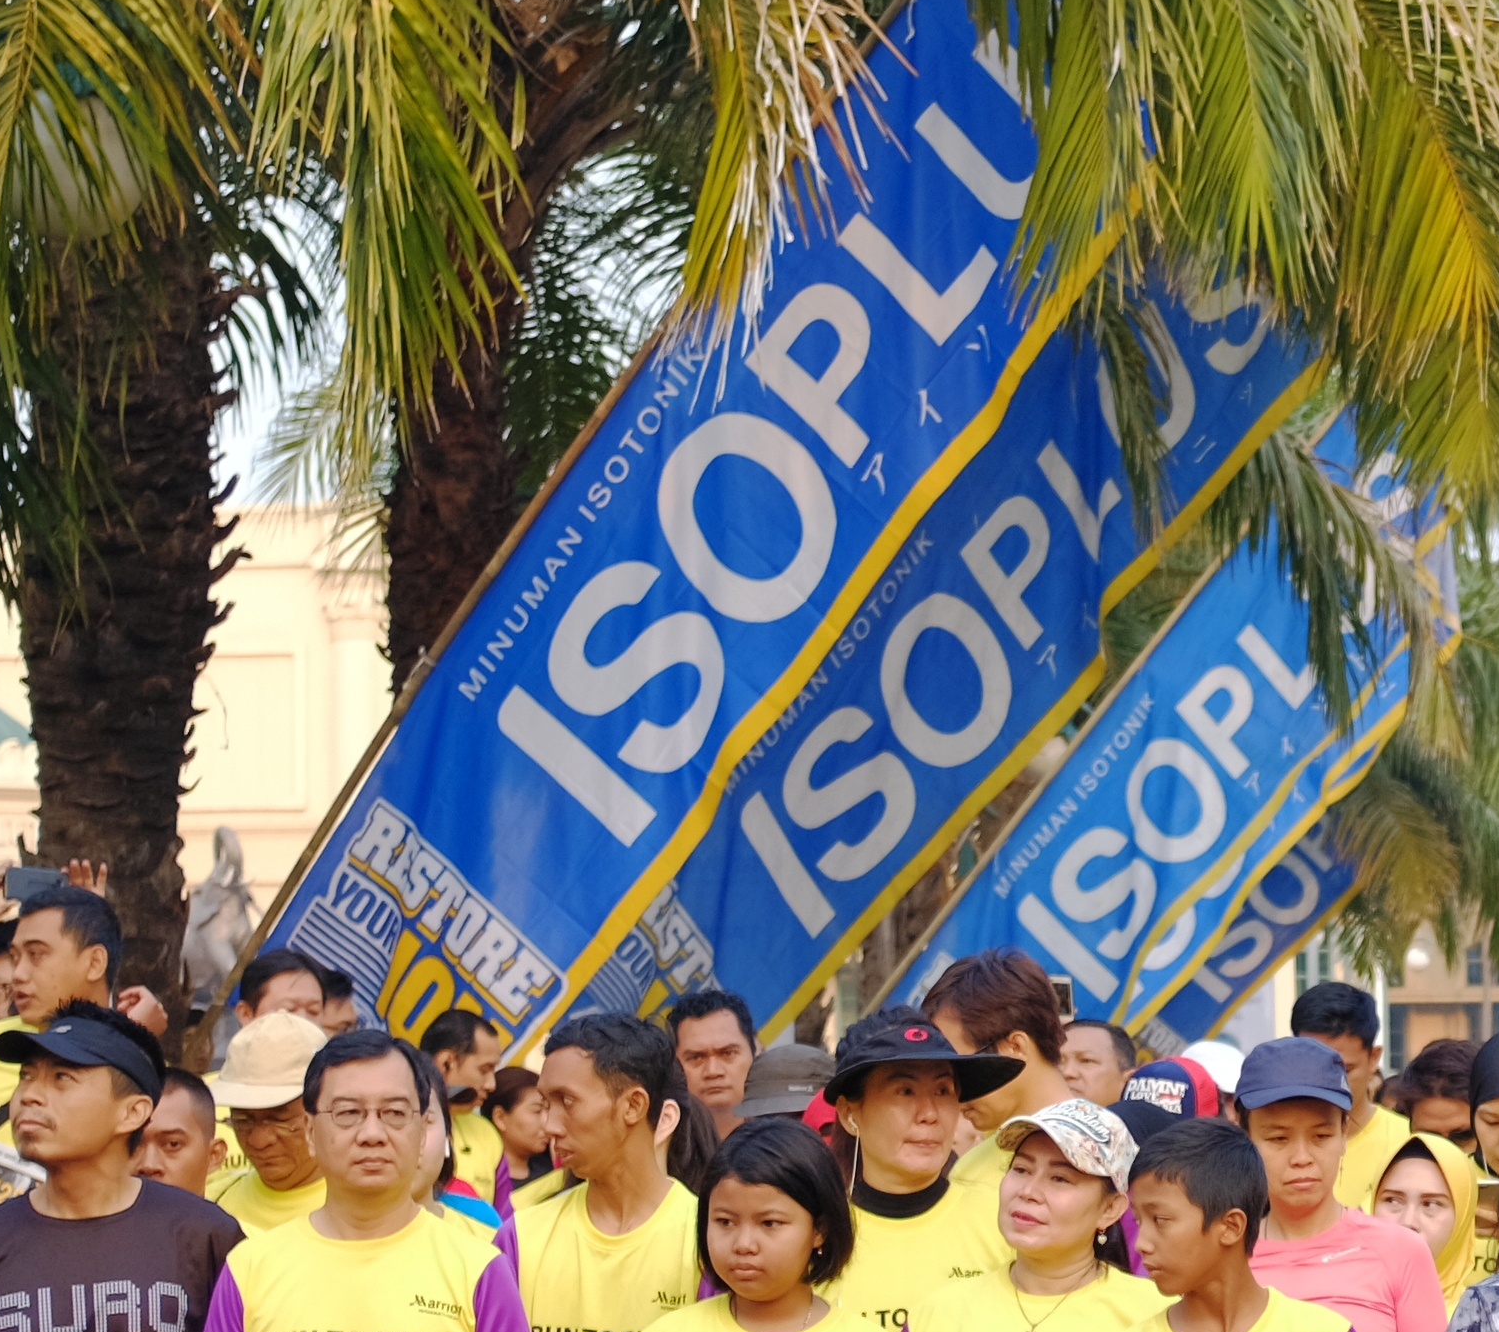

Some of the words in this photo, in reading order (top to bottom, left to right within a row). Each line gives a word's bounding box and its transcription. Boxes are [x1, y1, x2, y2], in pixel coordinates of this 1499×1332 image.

[458, 526, 583, 702] MINUMAN
[578, 341, 706, 524] ISOTONIK
[829, 530, 935, 669] ISOTONIK
[994, 797, 1079, 900] MINUMAN
[1074, 693, 1156, 801] ISOTONIK
[875, 1308, 908, 1328] TO
